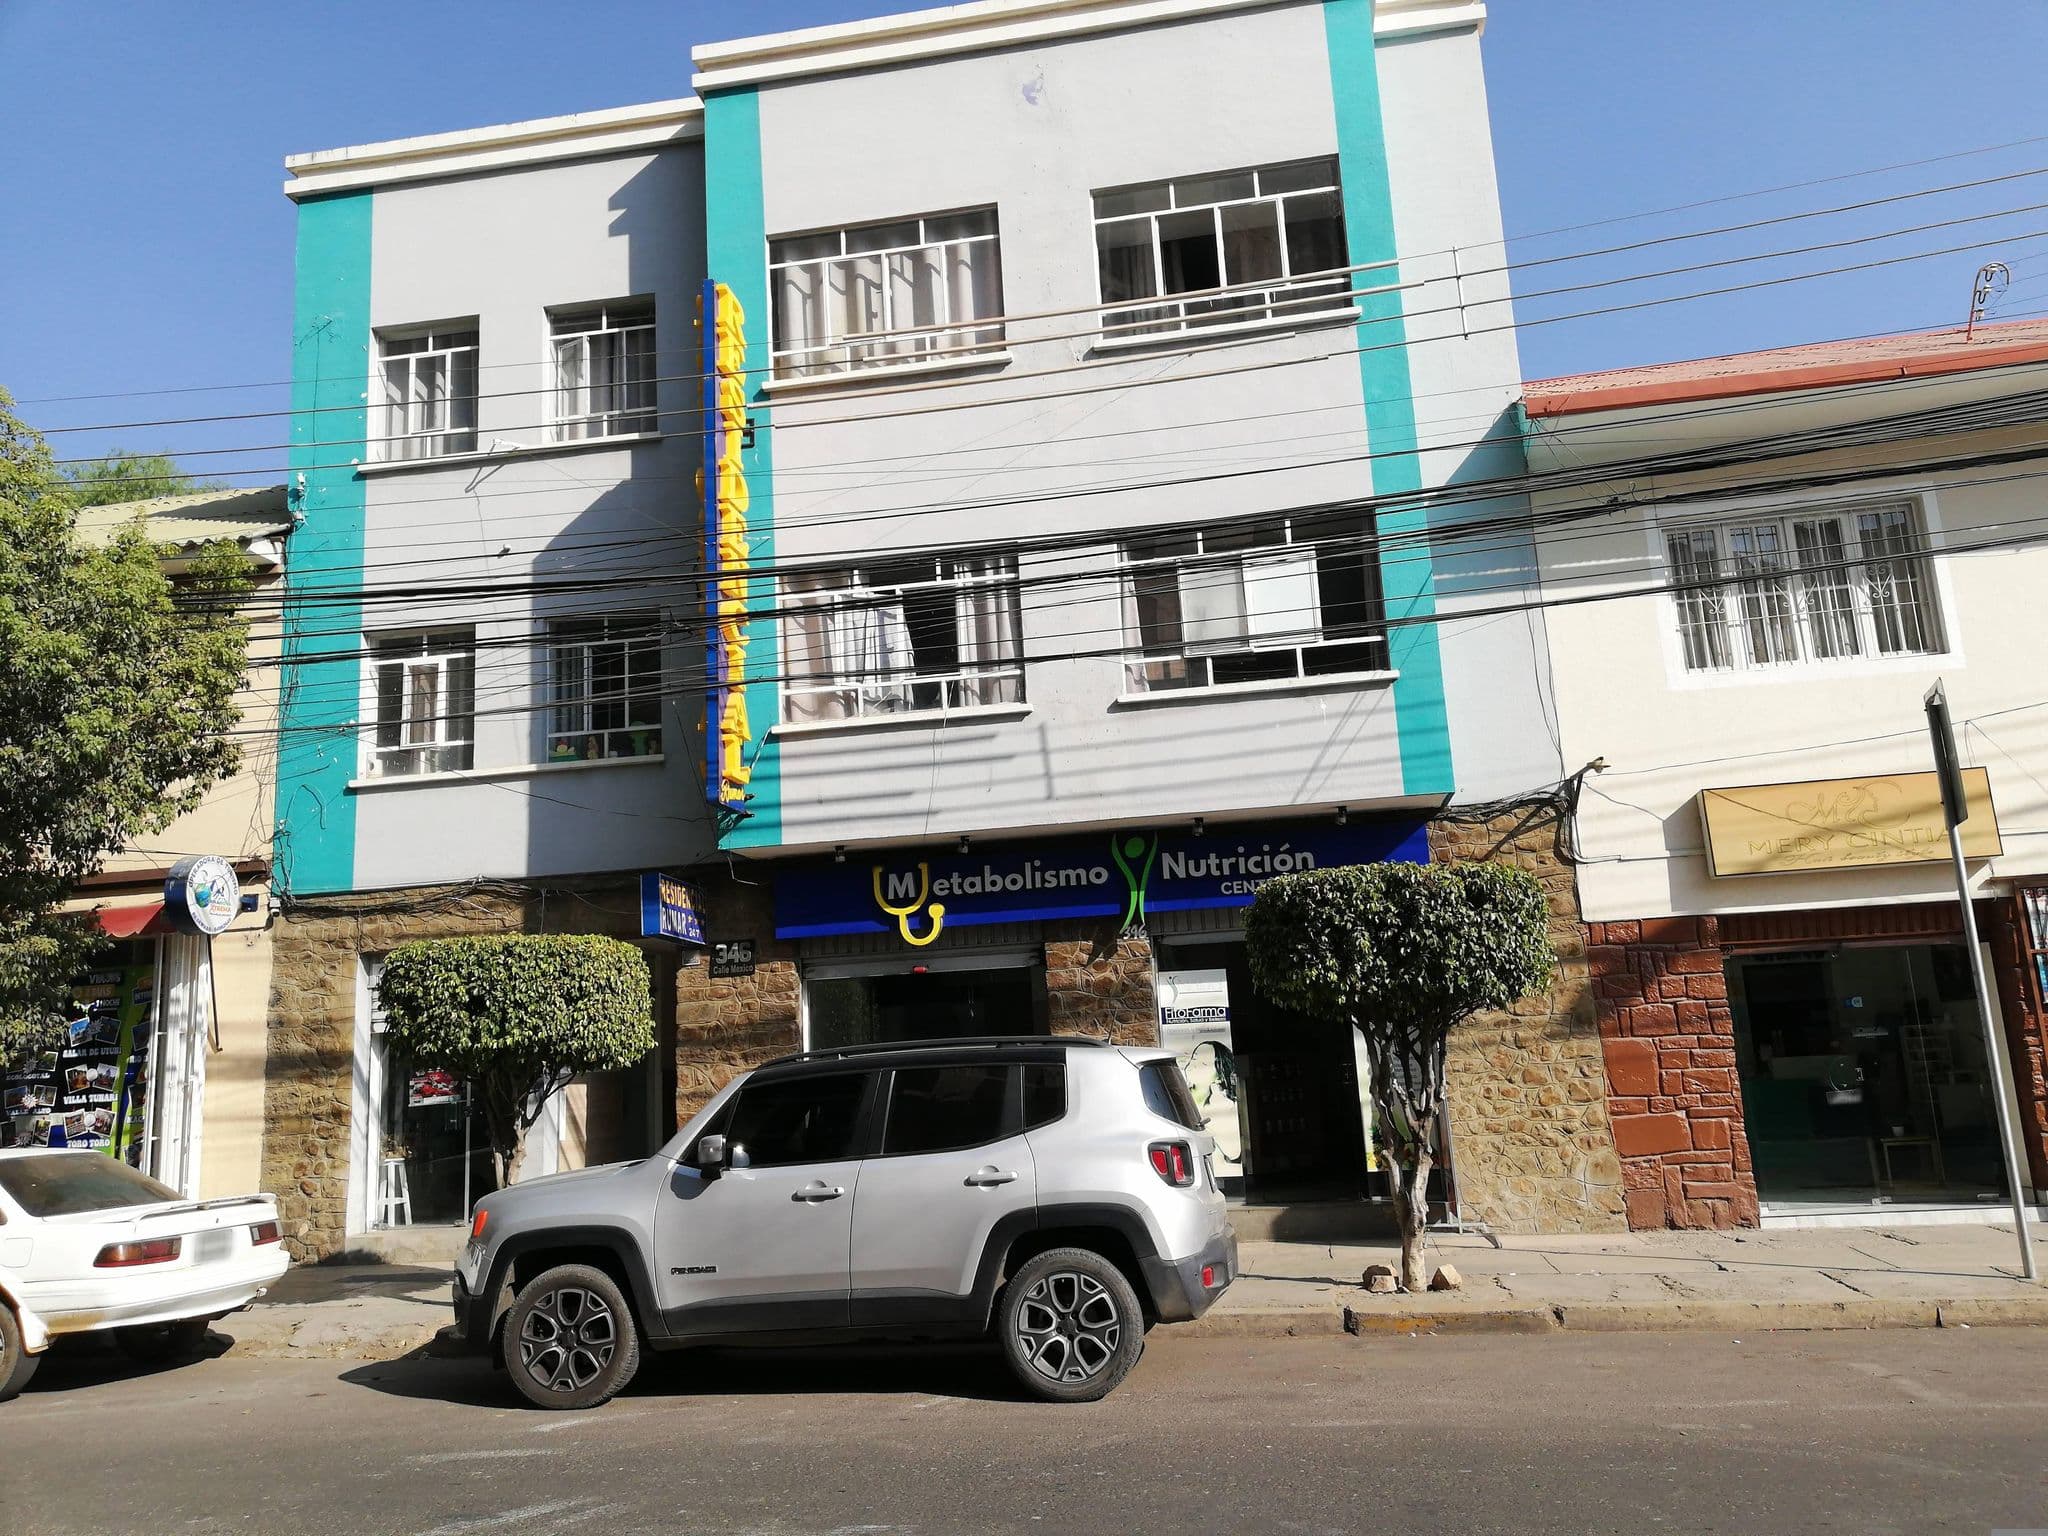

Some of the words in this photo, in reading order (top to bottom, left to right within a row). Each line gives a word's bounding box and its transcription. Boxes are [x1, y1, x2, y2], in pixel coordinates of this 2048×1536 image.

[1748, 834, 1834, 855] MERY
[888, 860, 1109, 899] Metabolismo
[1161, 843, 1315, 879] Nutrición
[715, 942, 752, 964] 346
[713, 965, 730, 975] Calle
[64, 1095, 87, 1105] VILLA
[66, 1139, 88, 1148] TORO
[89, 1138, 111, 1148] TORO
